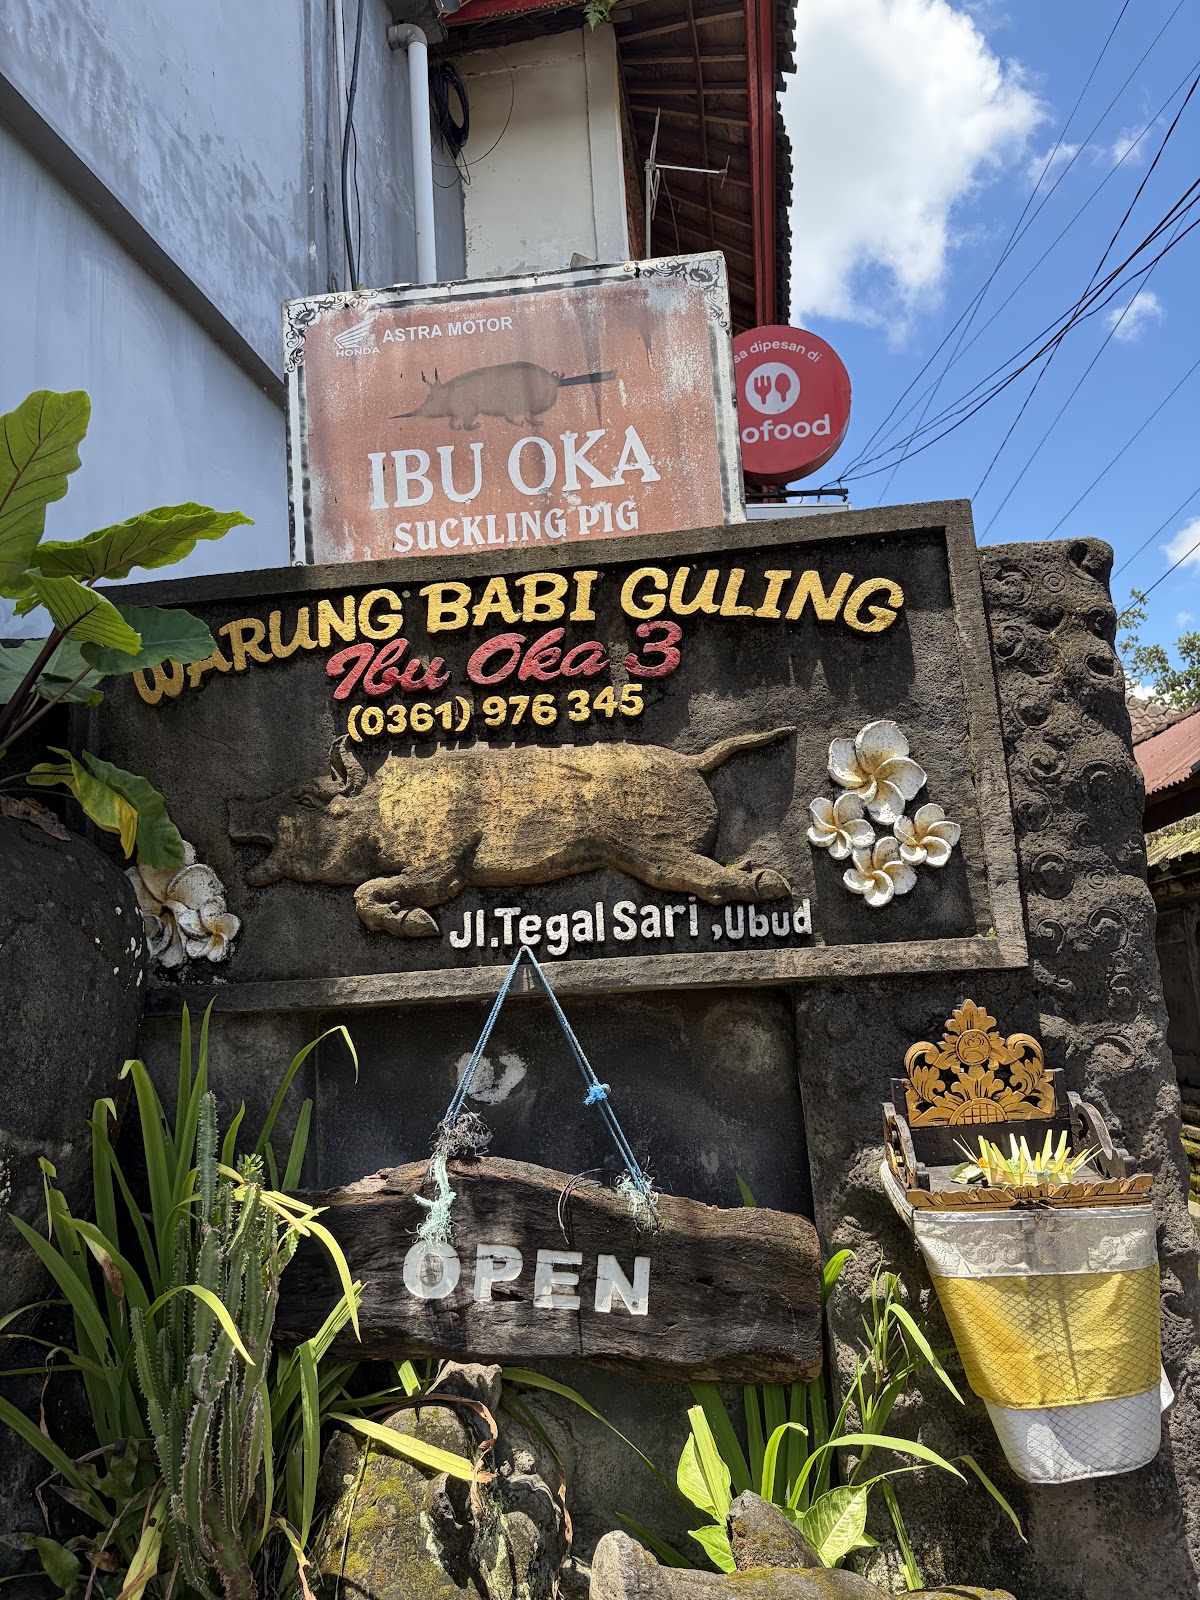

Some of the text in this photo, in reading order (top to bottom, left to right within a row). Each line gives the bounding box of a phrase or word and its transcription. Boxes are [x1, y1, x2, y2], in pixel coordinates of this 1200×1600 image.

[336, 346, 381, 358] HONDA
[382, 316, 514, 343] ASTRA MOTOR
[749, 340, 806, 355] dipesan
[807, 351, 823, 363] di
[741, 413, 831, 444] ofood
[367, 424, 661, 511] IBU OKA
[393, 500, 640, 553] SUCKLING PIG
[419, 570, 599, 633] BABI
[620, 566, 905, 634] GULING
[325, 620, 684, 700] Ibu Oka 3
[347, 683, 645, 743] (0361) 976 345
[612, 896, 699, 941] Sari
[402, 1239, 652, 1316] OPEN
